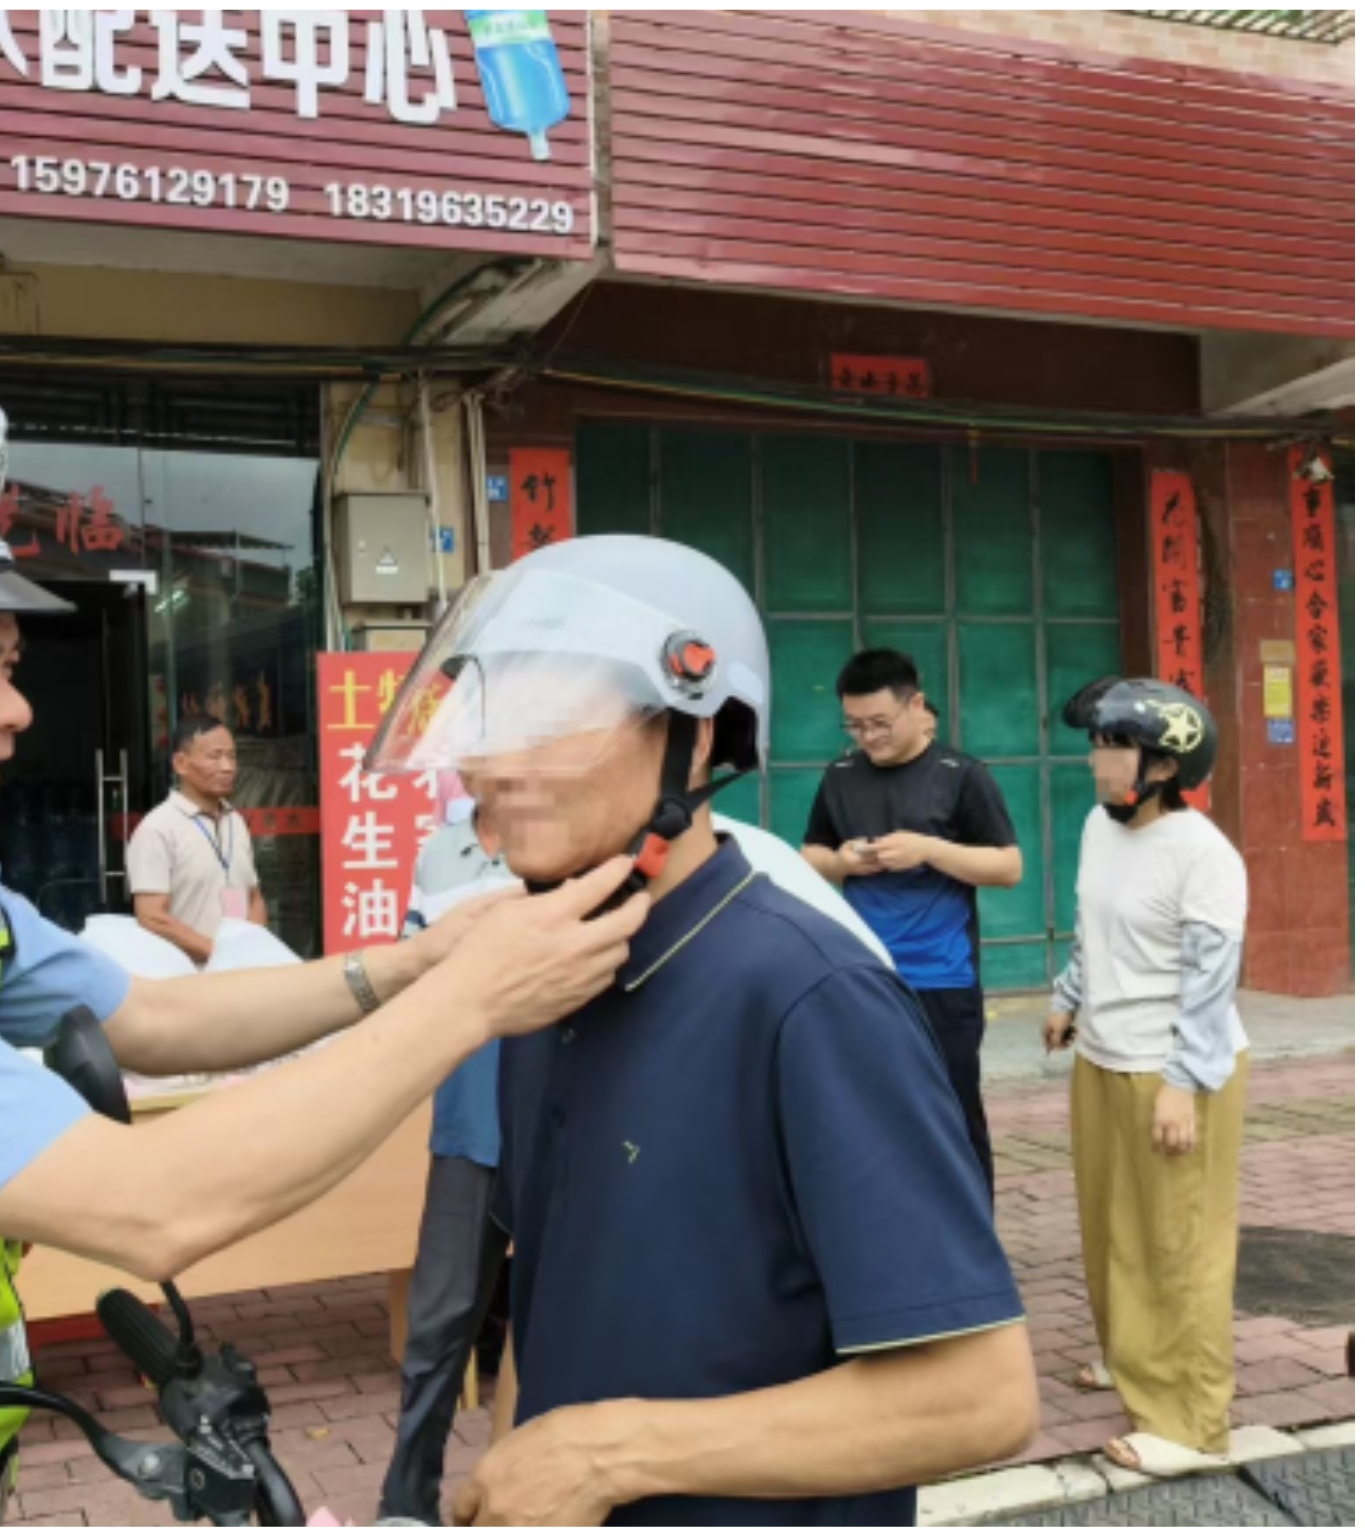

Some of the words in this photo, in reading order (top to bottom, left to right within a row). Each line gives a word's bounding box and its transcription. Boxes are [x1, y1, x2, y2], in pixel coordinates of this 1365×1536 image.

[11, 154, 290, 212] 15976129179
[324, 182, 574, 235] 18319635229
[338, 741, 399, 939] 花生油
